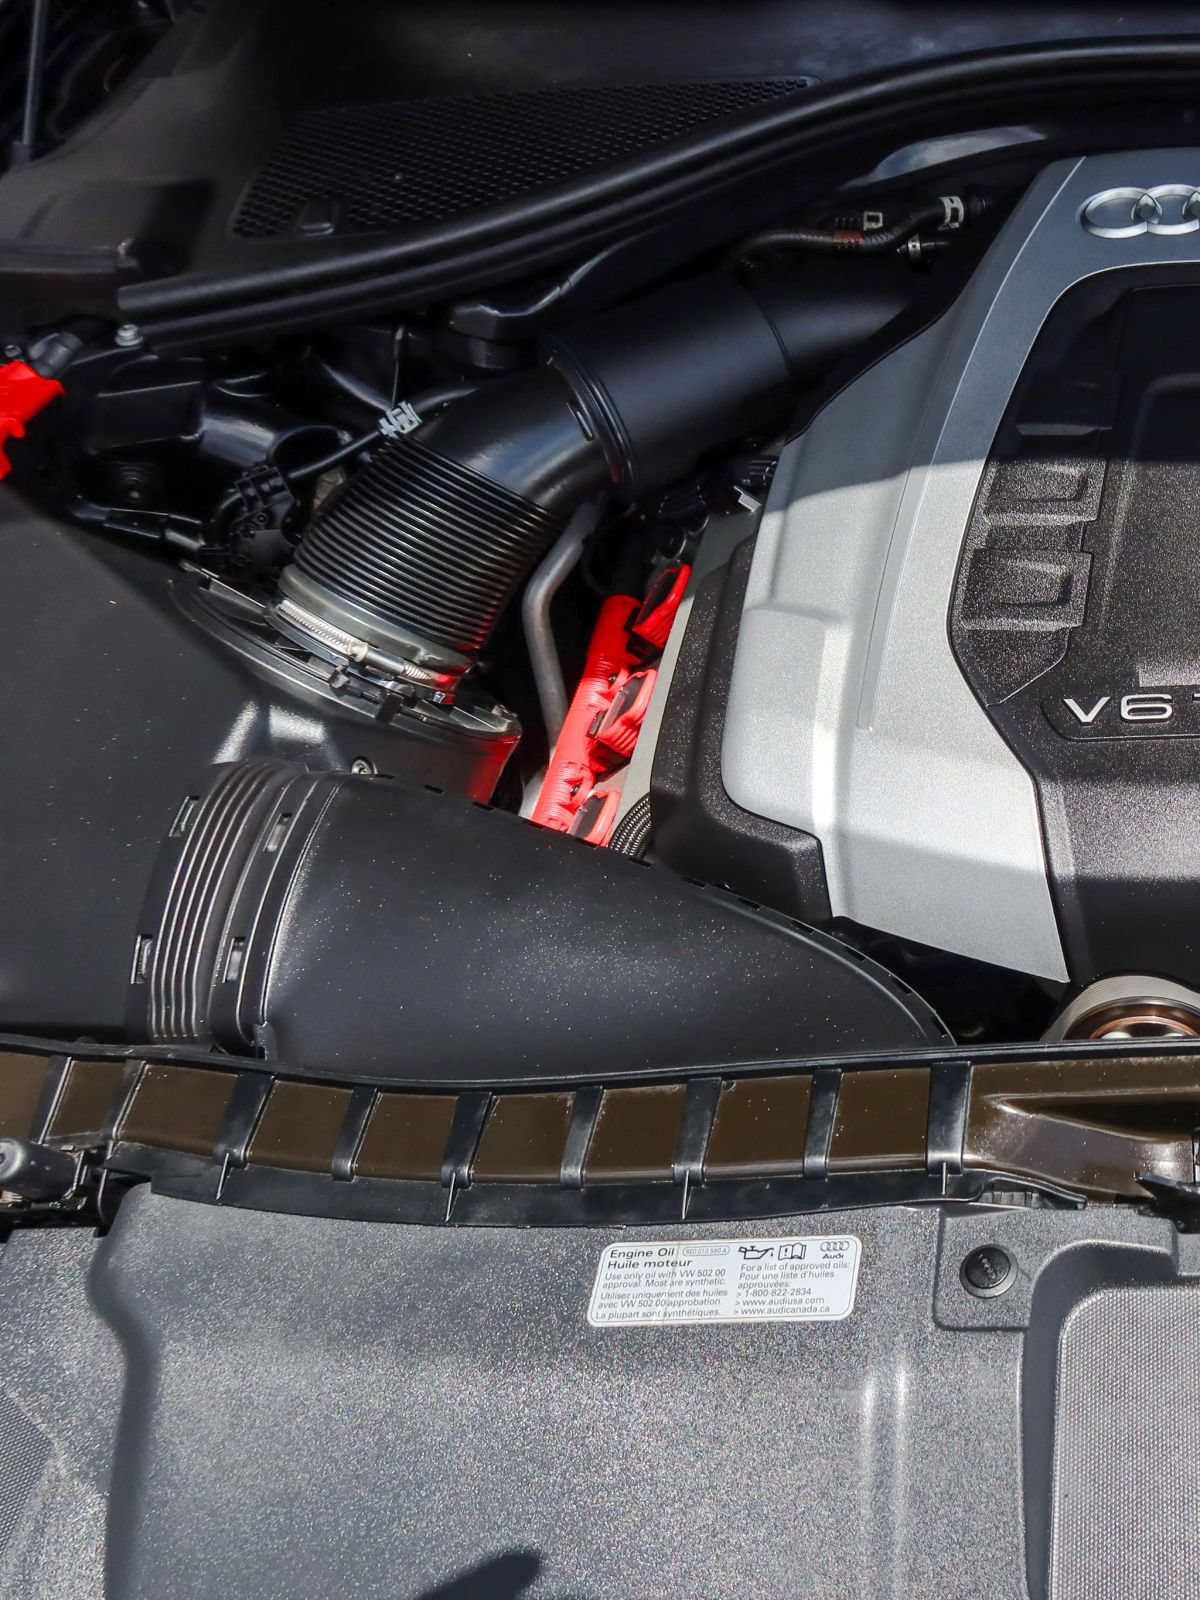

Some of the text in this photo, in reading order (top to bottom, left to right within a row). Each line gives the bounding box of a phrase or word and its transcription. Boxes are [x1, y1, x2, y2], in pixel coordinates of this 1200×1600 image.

[1063, 693, 1172, 726] V6
[610, 1248, 674, 1259] Engine Oil
[608, 1260, 639, 1269] Huile
[790, 1262, 830, 1271] approved
[623, 1272, 642, 1280] only
[603, 1280, 642, 1289] approval.
[686, 1278, 726, 1287] synthetic.
[738, 1282, 791, 1290] approuvées:
[632, 1291, 684, 1301] uniquement
[746, 1288, 811, 1297] 1-800-822-2834
[743, 1297, 824, 1306] www.audiusa.com
[608, 1311, 639, 1320] plupart
[664, 1309, 720, 1318] synthétiques.
[741, 1306, 830, 1314] www.audicanada.ca
